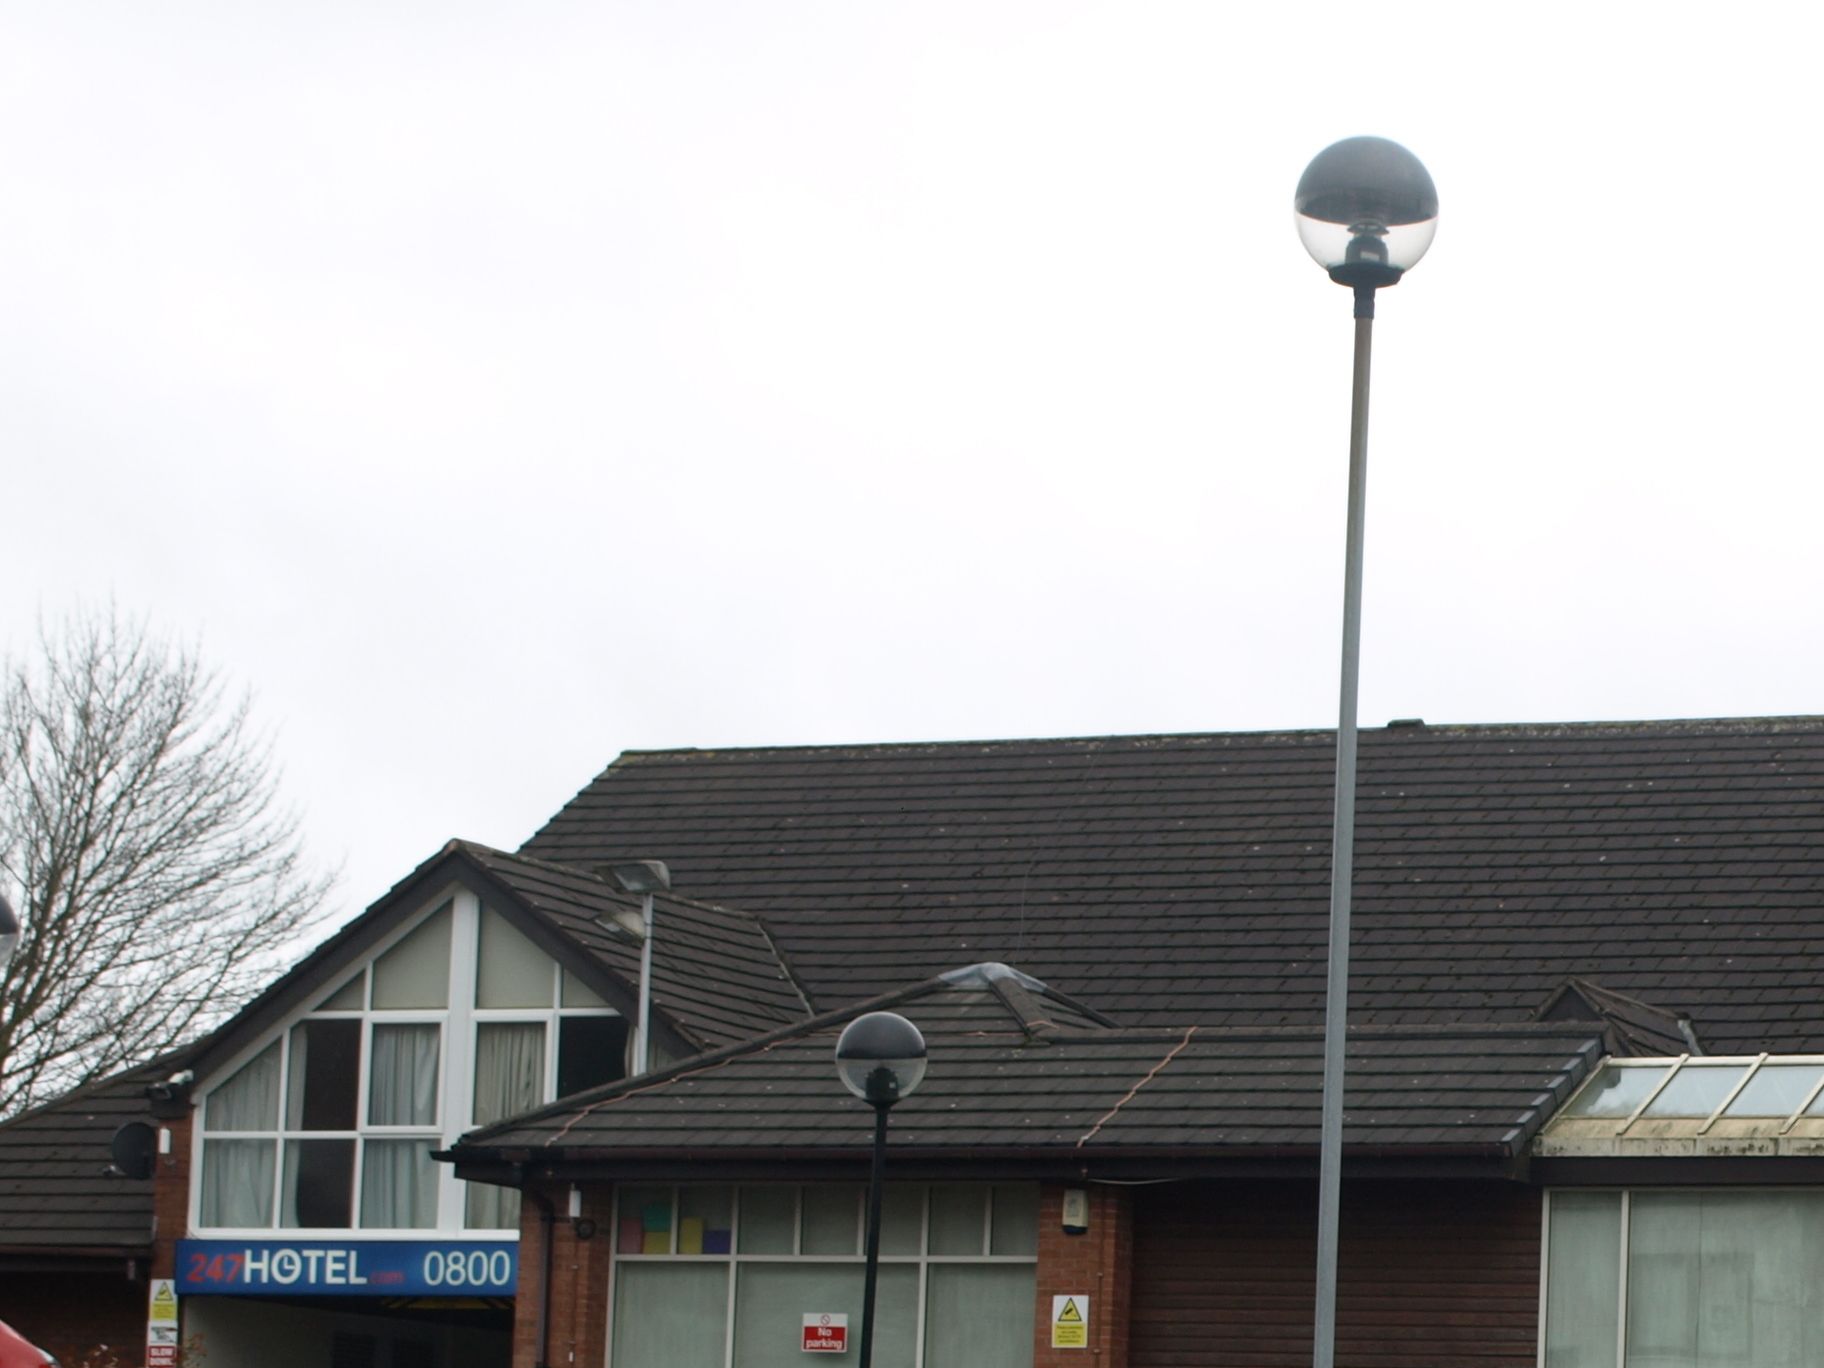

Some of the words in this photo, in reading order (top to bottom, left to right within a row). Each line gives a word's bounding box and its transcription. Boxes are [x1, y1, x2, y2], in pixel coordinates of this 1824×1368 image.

[423, 1250, 511, 1286] 0800
[817, 1327, 832, 1337] No
[806, 1338, 843, 1350] parking
